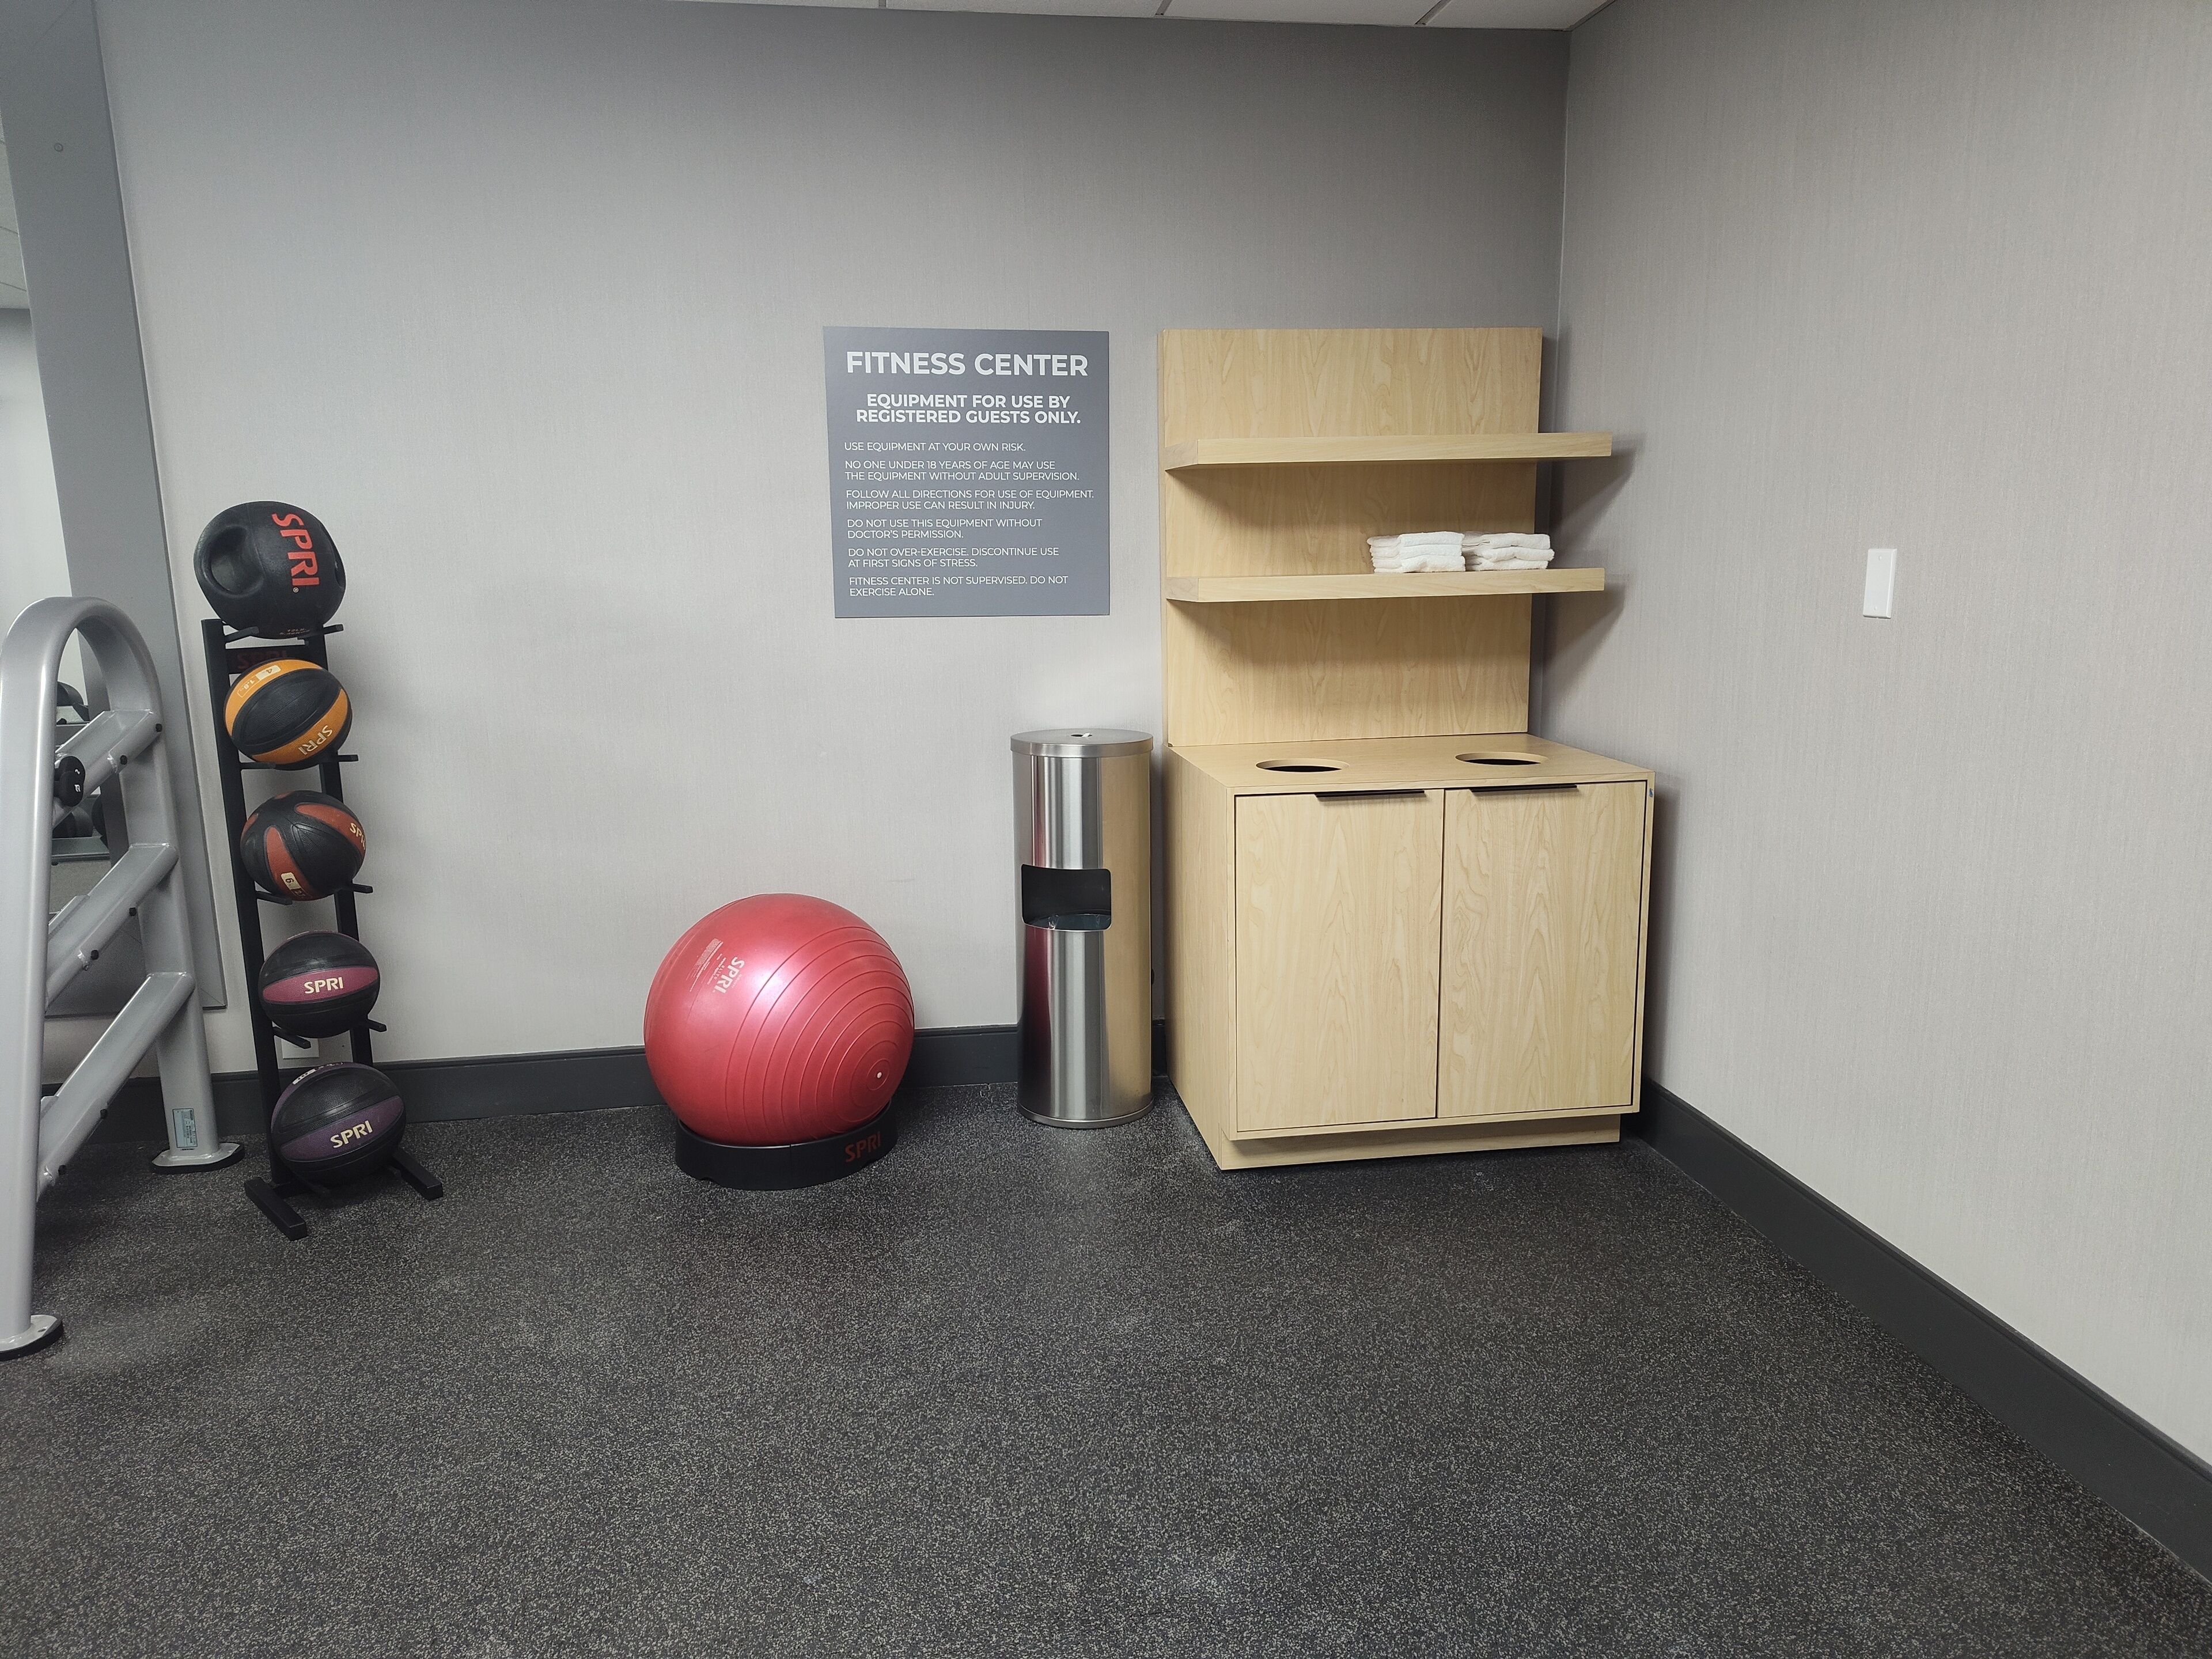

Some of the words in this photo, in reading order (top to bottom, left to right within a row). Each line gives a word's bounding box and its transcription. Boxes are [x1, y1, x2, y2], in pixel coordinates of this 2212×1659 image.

[847, 351, 965, 374] FITNESS
[975, 353, 1088, 376] CENTER
[868, 393, 967, 409] EQUIPMENT
[973, 394, 1006, 407] FOR
[1012, 395, 1043, 408] USE
[1049, 396, 1070, 409] BY
[857, 409, 961, 423] REGISTERED
[966, 411, 1030, 423] GUESTS
[1035, 411, 1081, 423] ONLY.
[844, 442, 864, 450] USE
[868, 442, 926, 452] EQUIPMENT
[973, 443, 998, 451] OWN
[1002, 443, 1025, 451] RISK.
[863, 461, 886, 469] ONE
[889, 461, 924, 469] UNDER
[926, 461, 936, 469] 18
[938, 461, 971, 469] YEARS
[974, 461, 987, 469] OF
[990, 461, 1010, 469] AGE
[844, 472, 865, 480] THE
[868, 472, 927, 481] EQUIPMENT
[929, 472, 976, 480] WITHOUT
[978, 472, 1011, 480] ADULT
[846, 490, 889, 498] FOLLOW
[892, 490, 910, 498] ALL
[913, 489, 972, 498] DIRECTIONS
[1020, 490, 1033, 498] OF
[1036, 490, 1094, 499] EQUIPMENT.
[847, 501, 899, 509] IMPROPER
[902, 501, 921, 509] USE
[924, 501, 945, 509] CAN
[948, 501, 984, 509] RESULT
[987, 501, 996, 509] IN
[1000, 501, 1035, 509] INJURY.
[889, 520, 909, 528] USE
[911, 519, 933, 527] THIS
[936, 519, 994, 528] EQUIPMENT
[996, 518, 1043, 527] WITHOUT
[902, 530, 964, 539] PERMISSION.
[271, 513, 320, 586] SPRI
[849, 548, 864, 556] DO
[867, 548, 888, 556] NOT
[890, 548, 969, 556] OVER-EXERCISE.
[972, 548, 1037, 556] DISCONTINUE
[1040, 547, 1059, 555] USE
[849, 559, 861, 567] AT
[863, 559, 889, 567] FIRST
[892, 559, 921, 567] SIGNS
[923, 559, 937, 567] OF
[940, 559, 978, 567] STRESS.
[850, 577, 888, 585] FITNESS
[891, 577, 929, 585] CENTER
[966, 576, 1027, 584] SUPERVISED.
[1031, 576, 1045, 584] DO
[850, 588, 896, 596] EXERCISE
[899, 588, 934, 596] ALONE.
[298, 725, 332, 755] SPRI
[714, 956, 745, 994] SPRI
[304, 976, 344, 994] SPRI
[330, 1120, 373, 1148] SPRI
[845, 1131, 881, 1162] SPRI
